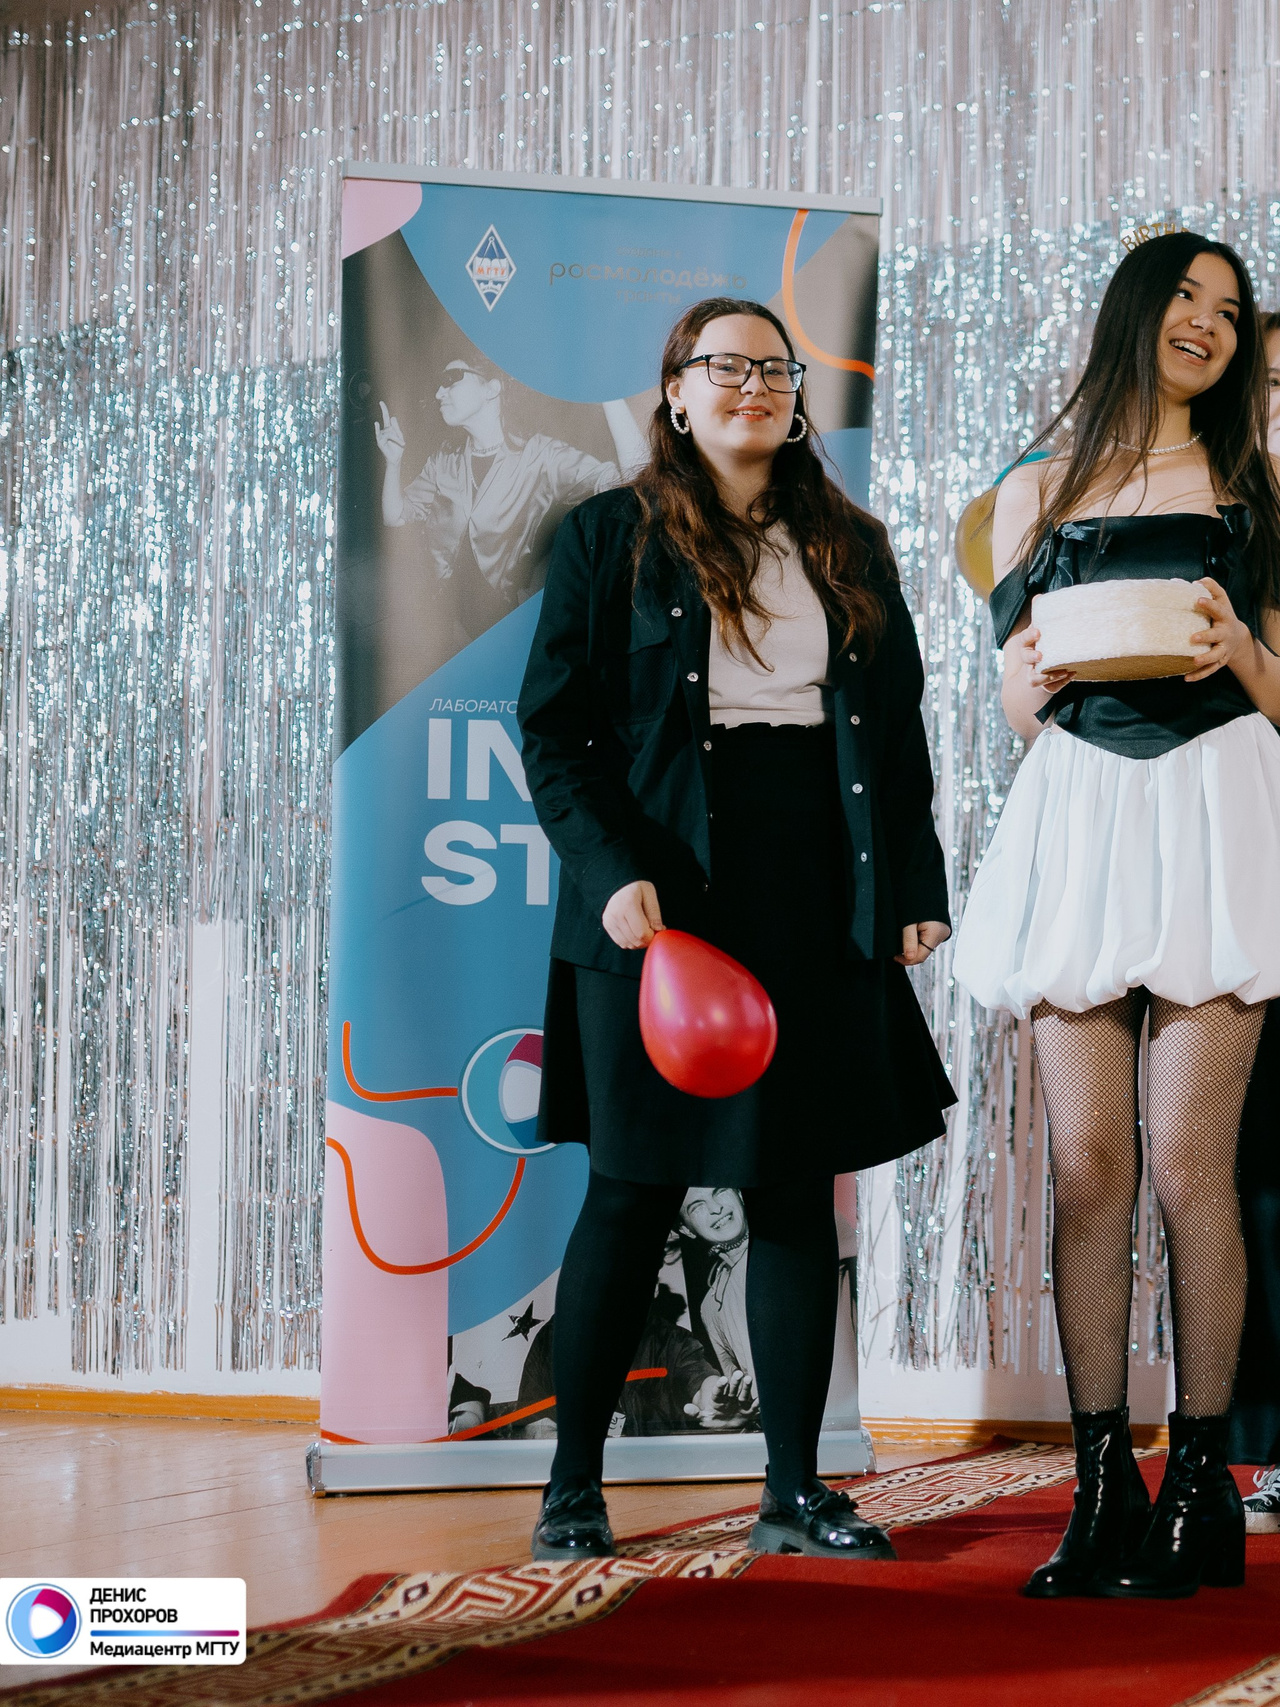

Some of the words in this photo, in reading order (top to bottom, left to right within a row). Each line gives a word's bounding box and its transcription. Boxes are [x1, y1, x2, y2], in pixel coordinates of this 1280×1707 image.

[476, 266, 506, 276] МГТУ
[549, 261, 747, 290] росмолодёжь
[616, 289, 681, 305] гранты
[421, 820, 551, 906] ST
